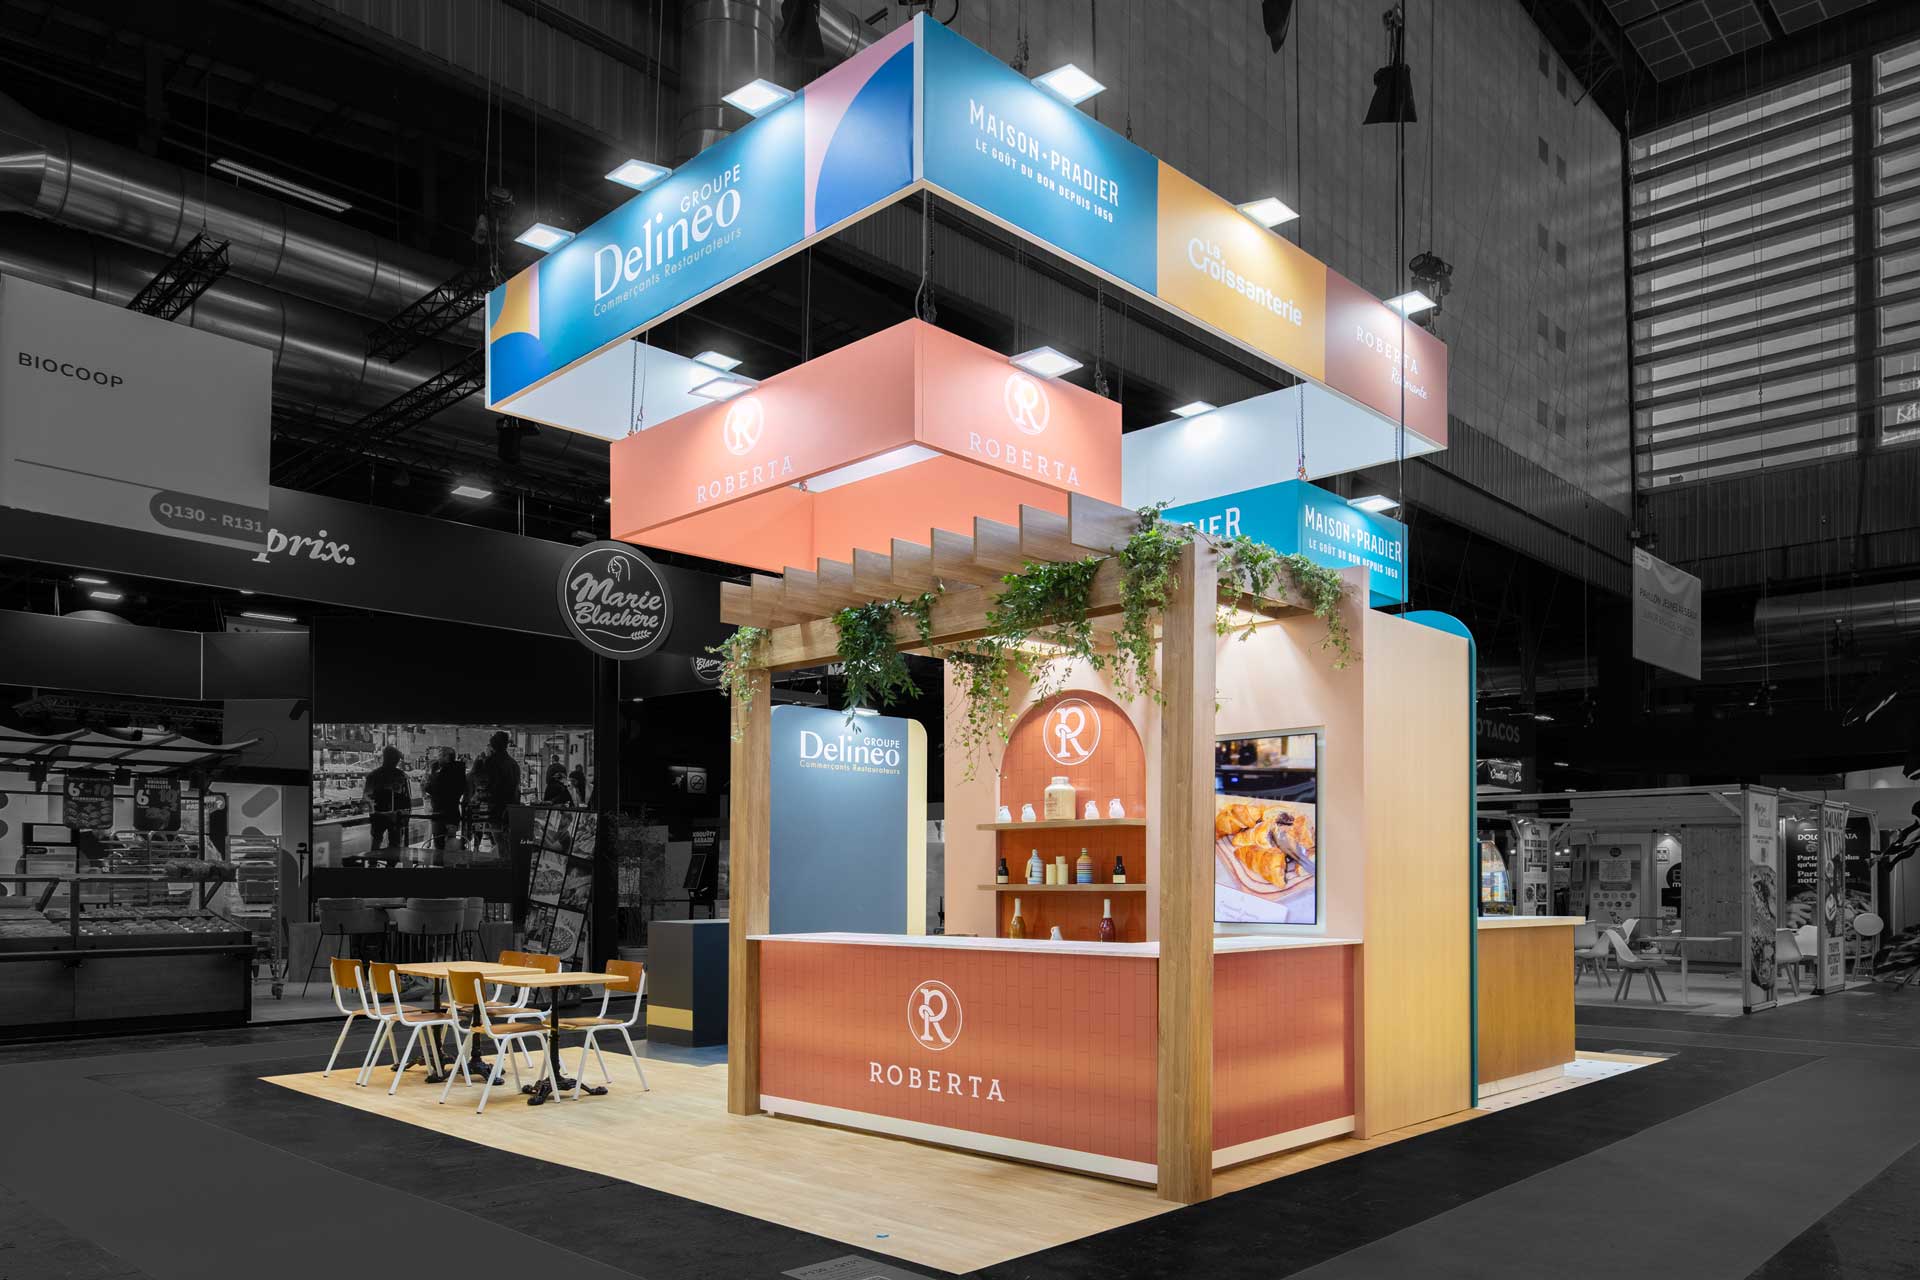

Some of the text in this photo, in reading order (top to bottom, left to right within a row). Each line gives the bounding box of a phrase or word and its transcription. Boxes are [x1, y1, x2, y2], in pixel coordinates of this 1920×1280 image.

[969, 99, 1119, 207] MAISON PRADIER
[680, 164, 741, 212] GROUPE
[975, 138, 987, 154] LE
[992, 149, 1016, 169] GOÛT
[1021, 164, 1033, 179] DU
[1036, 172, 1055, 191] BON
[1059, 184, 1090, 210] DEPUIS
[594, 189, 741, 301] Delineo
[1206, 240, 1220, 259] La
[594, 228, 742, 317] Commerçants Restaurateurs
[1187, 238, 1302, 326] Croissanterie
[19, 352, 123, 388] BIOCOOP
[1356, 325, 1419, 374] ROBERTA
[697, 455, 793, 503] ROBERTA
[968, 431, 1081, 487] ROBERTA
[159, 502, 205, 523] Q130
[222, 514, 264, 533] R131
[1305, 504, 1350, 543] MAISON
[570, 572, 663, 611] Marie
[574, 601, 659, 629] Blachère
[800, 730, 900, 767] Delineo
[863, 737, 900, 749] GROUPE
[800, 760, 901, 775] Commerçants Restaurateurs
[869, 1062, 1006, 1103] ROBERTA
